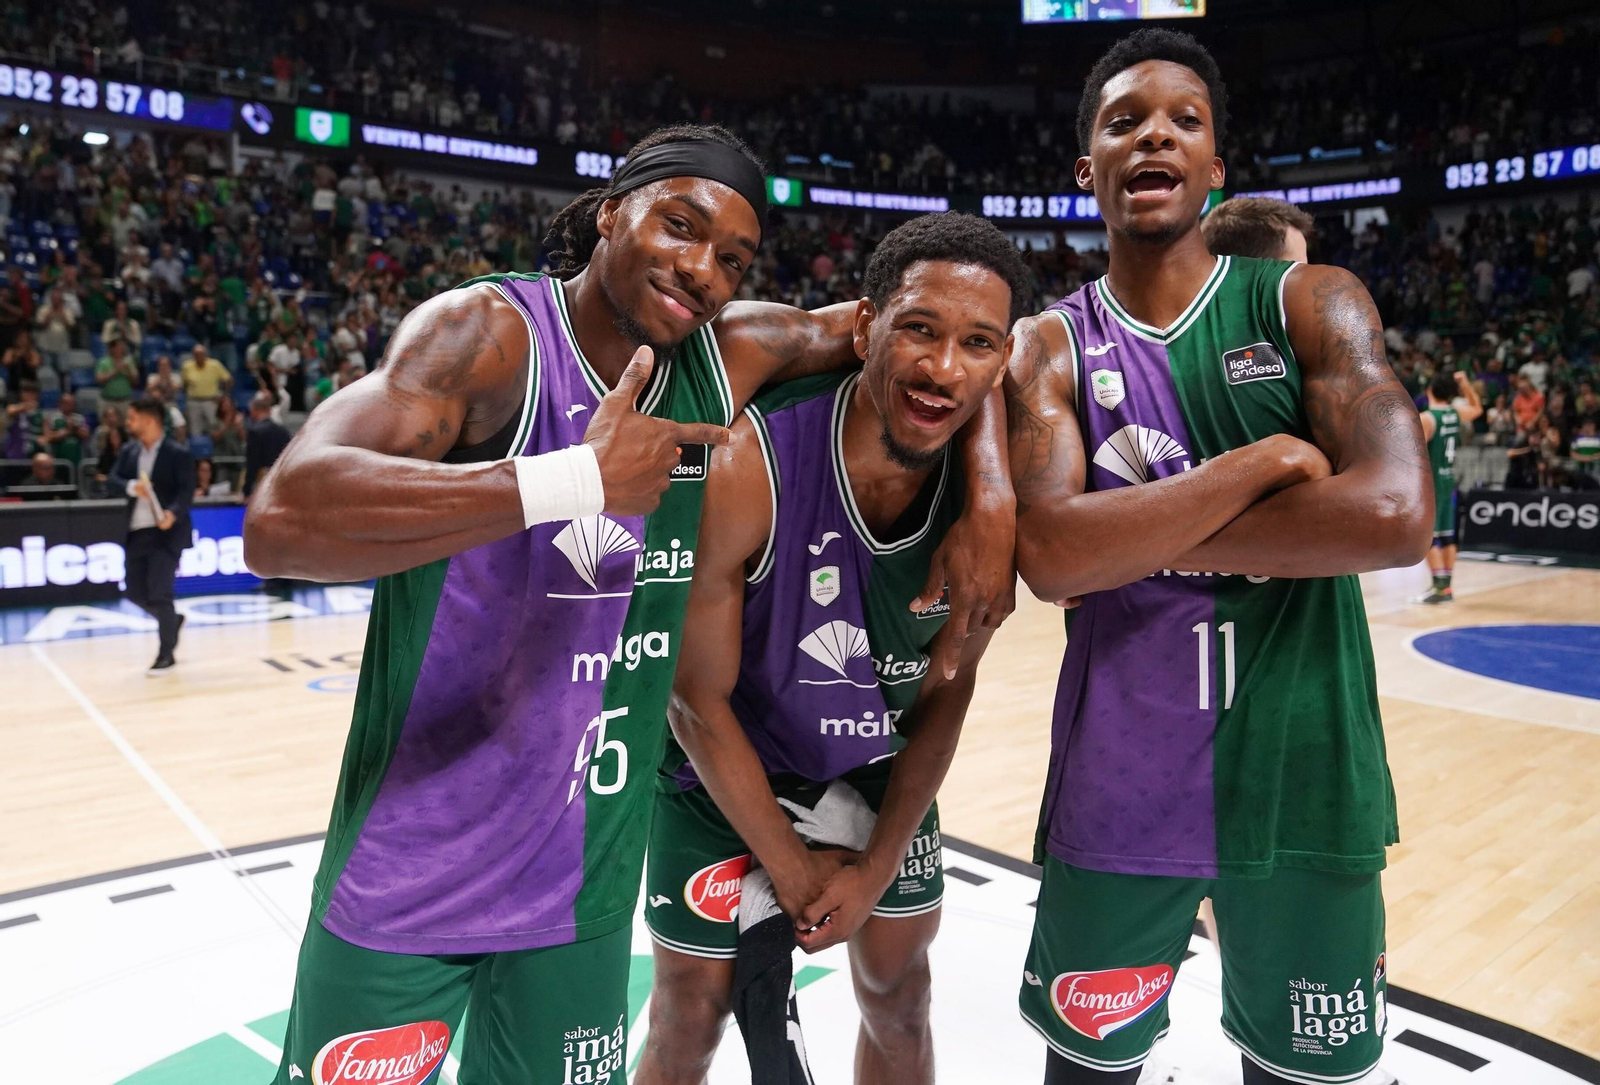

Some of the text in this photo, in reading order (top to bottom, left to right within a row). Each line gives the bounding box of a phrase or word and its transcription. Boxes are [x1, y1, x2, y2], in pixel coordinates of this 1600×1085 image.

[0, 64, 185, 121] 952 23 57 08
[362, 124, 538, 166] VENTA DE ENTRADAS
[575, 150, 613, 179] 952
[1287, 187, 1311, 204] DE
[1311, 176, 1402, 202] ENTRADAS
[1445, 161, 1489, 190] 952
[1495, 156, 1526, 183] 23
[1532, 149, 1564, 178] 57
[983, 195, 1018, 218] 952
[1020, 196, 1045, 218] 23
[1047, 196, 1072, 218] 57
[1230, 359, 1253, 370] liga
[1232, 365, 1281, 379] endesa
[1192, 621, 1236, 710] 11
[1060, 970, 1170, 1010] famadesa
[1289, 978, 1328, 992] sabor
[1290, 978, 1369, 1015] a má
[563, 1013, 625, 1062] a má
[564, 1026, 601, 1040] sabor
[1290, 1004, 1369, 1046] laga
[562, 1048, 623, 1085] laga
